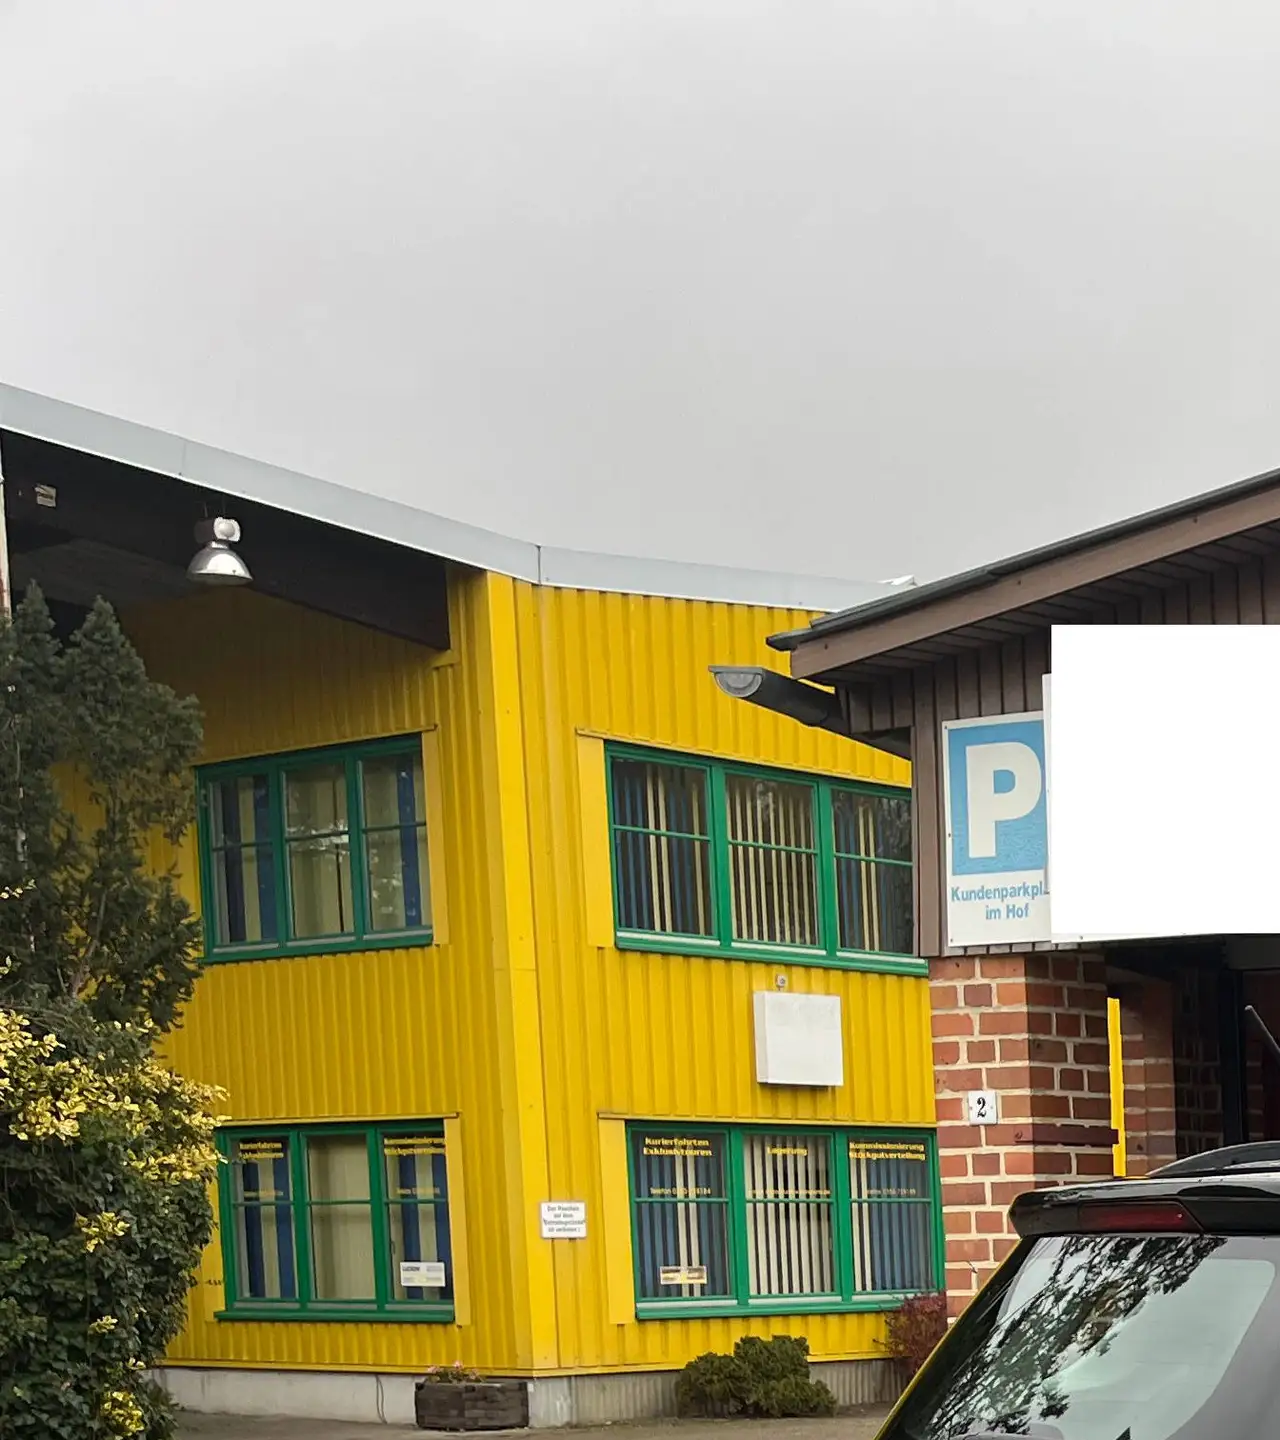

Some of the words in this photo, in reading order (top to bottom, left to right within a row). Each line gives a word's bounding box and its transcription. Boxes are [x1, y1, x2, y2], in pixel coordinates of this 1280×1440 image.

[966, 741, 1042, 859] P
[951, 881, 1043, 903] Kundenparkpl
[985, 905, 1001, 920] im
[1006, 903, 1030, 919] Hof
[976, 1096, 987, 1118] 2
